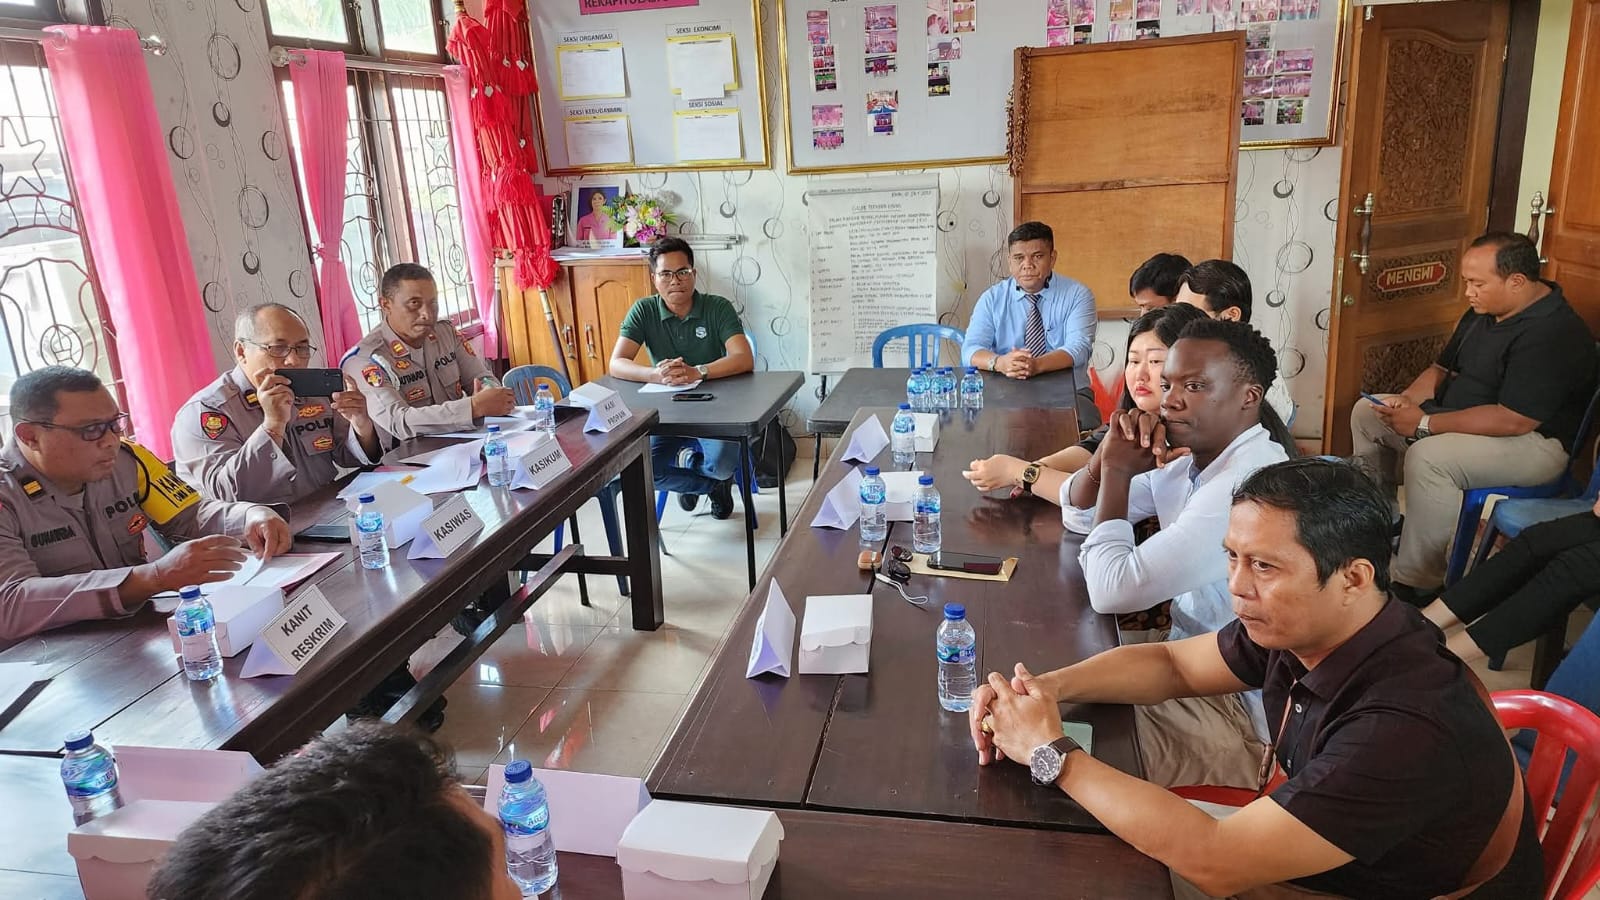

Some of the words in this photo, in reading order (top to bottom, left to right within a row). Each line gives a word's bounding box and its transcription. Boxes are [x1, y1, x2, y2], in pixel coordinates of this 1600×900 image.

[563, 35, 579, 43] SEKSI
[579, 33, 613, 42] ORGANISASI
[675, 26, 691, 34] SEKSI
[693, 25, 721, 33] EKONOMI
[569, 108, 585, 116] SEKSI
[704, 99, 724, 107] SOSIAL
[1386, 266, 1435, 286] MENGWI
[528, 449, 563, 476] KASIKUM
[433, 508, 472, 541] KASIWAS
[280, 604, 314, 637] KANIT
[291, 618, 336, 662] RESKRIM
